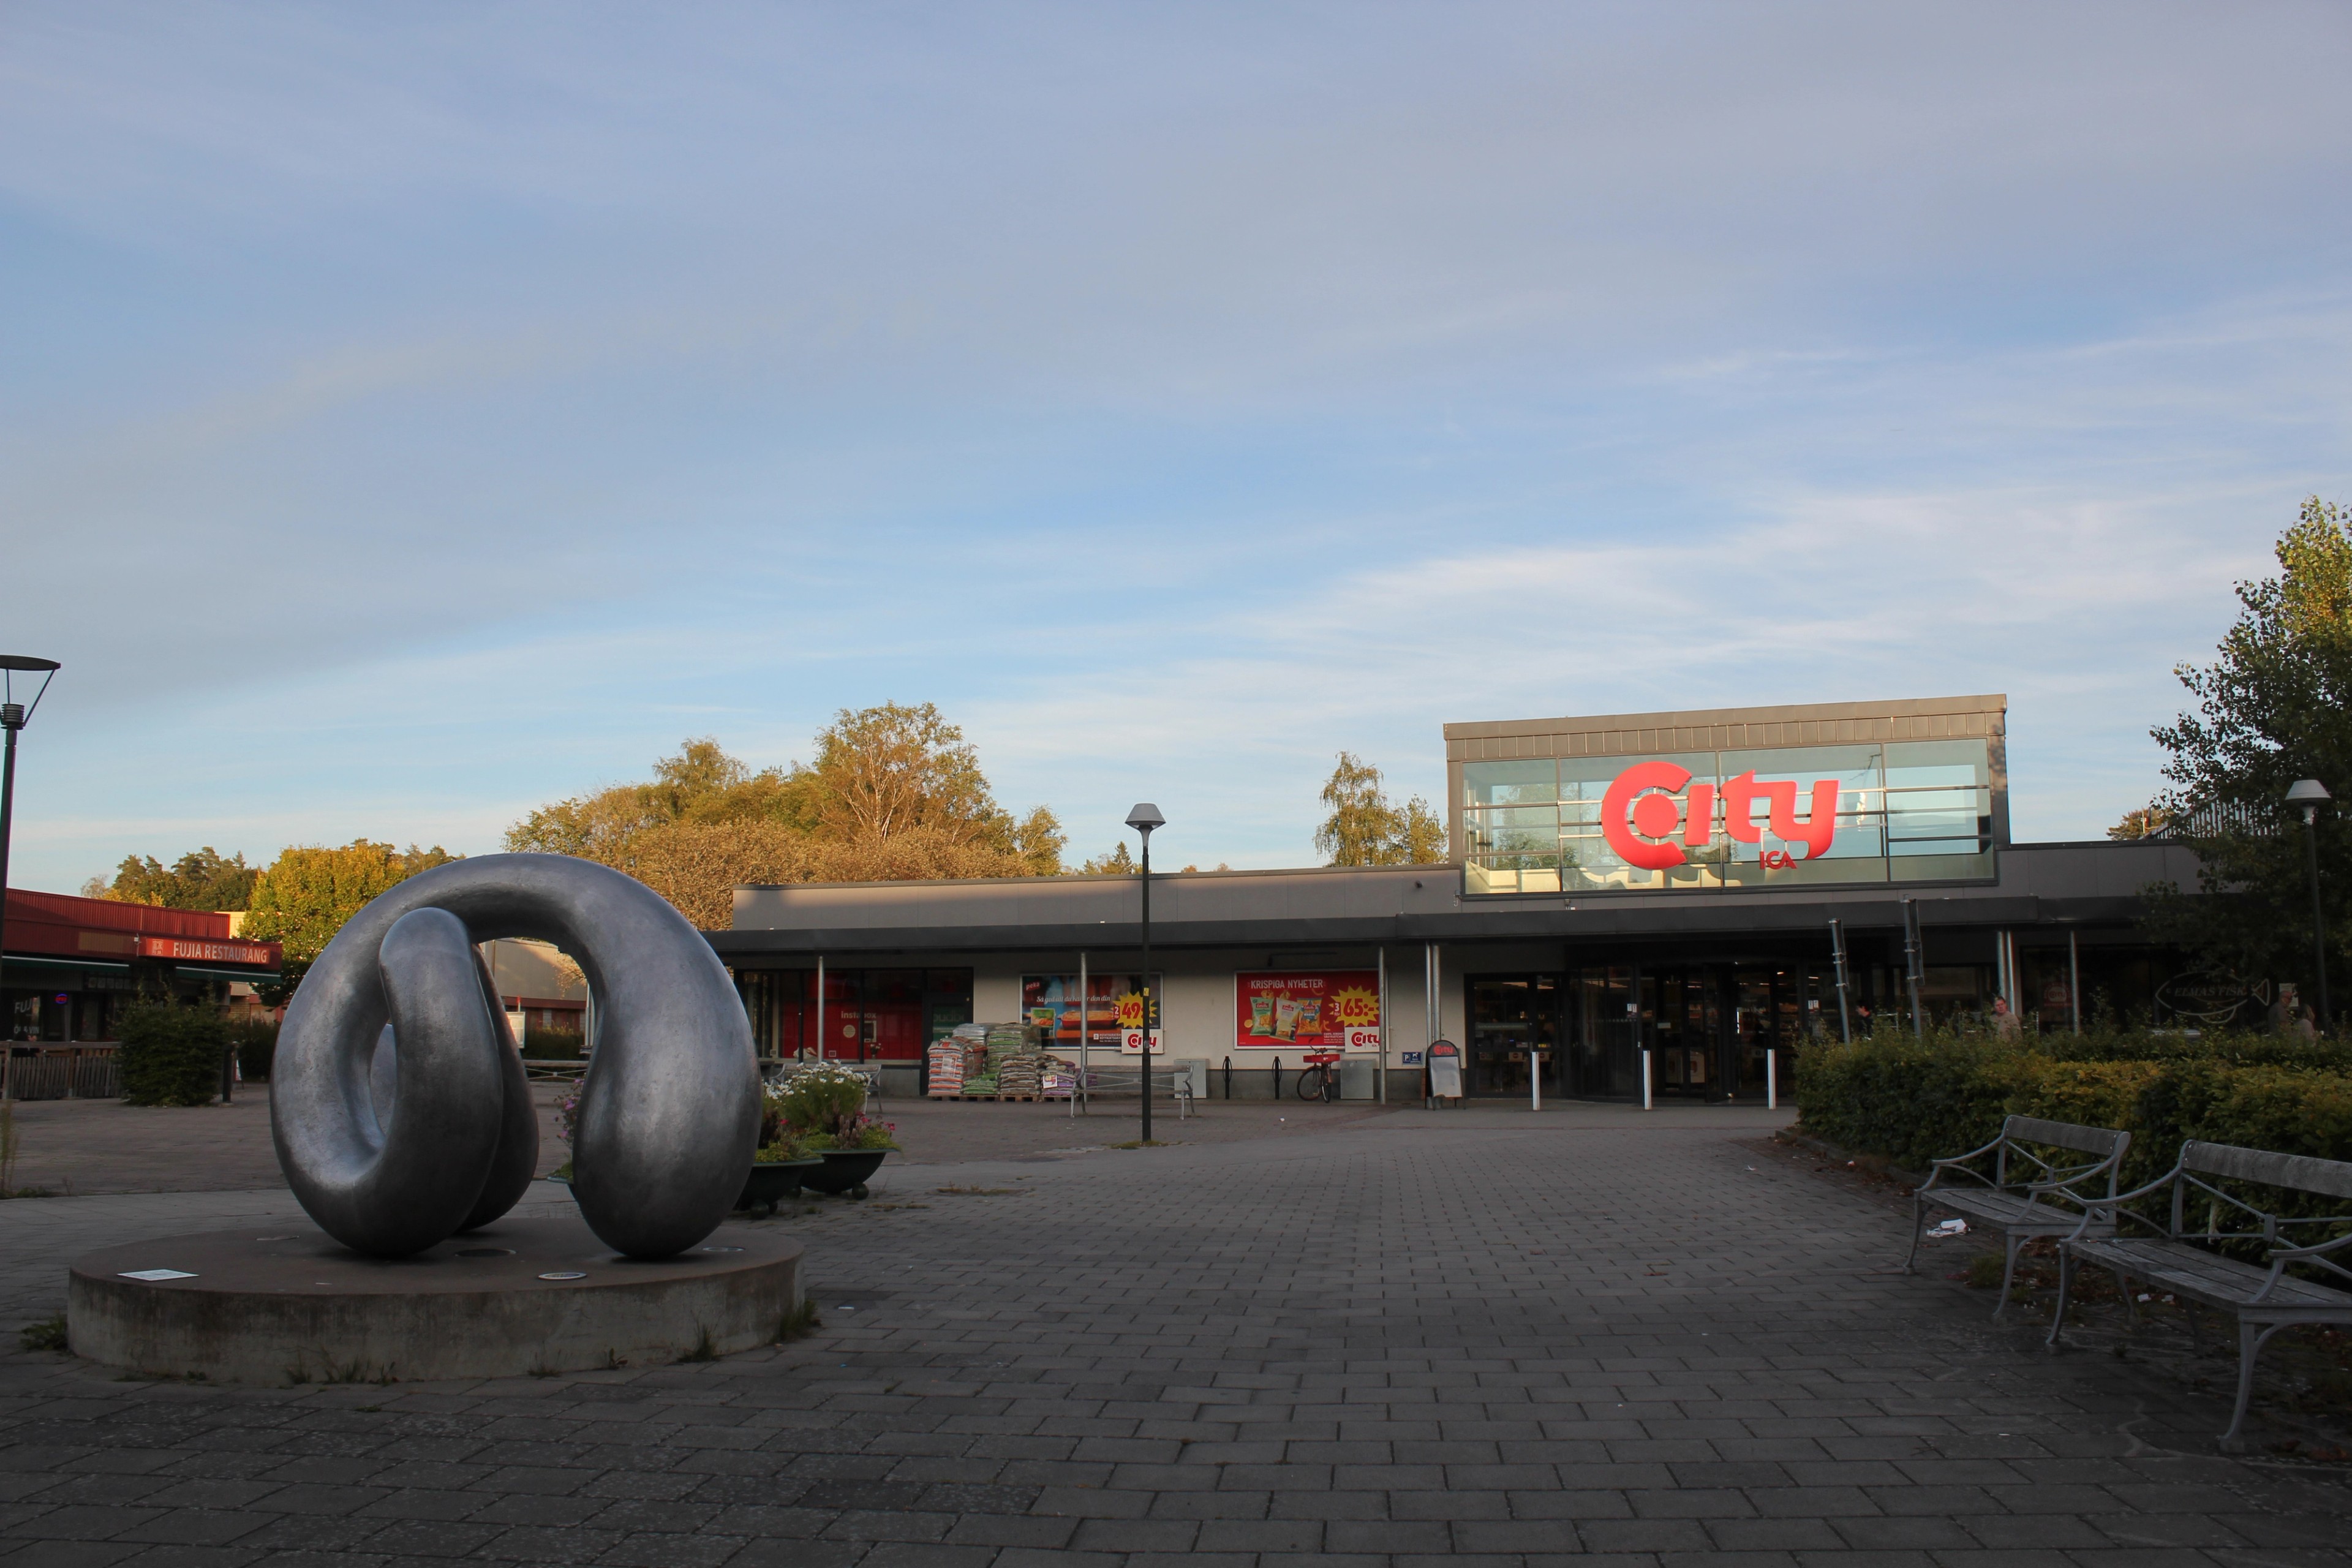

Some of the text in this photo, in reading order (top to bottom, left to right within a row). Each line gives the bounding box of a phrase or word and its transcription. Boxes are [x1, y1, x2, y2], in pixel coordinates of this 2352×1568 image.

[1601, 761, 1839, 870] City
[1760, 850, 1798, 870] ICA
[173, 941, 202, 958] FUJIA
[205, 944, 268, 963] RESTAURANG
[1026, 982, 1040, 990] peka
[1287, 979, 1323, 988] NYHETER
[1114, 1006, 1120, 1014] 2
[1122, 1002, 1144, 1019] 49:
[1335, 1003, 1340, 1012] 3
[1343, 998, 1374, 1017] 65:-
[1128, 1034, 1156, 1048] Ciy
[1434, 1045, 1454, 1055] City
